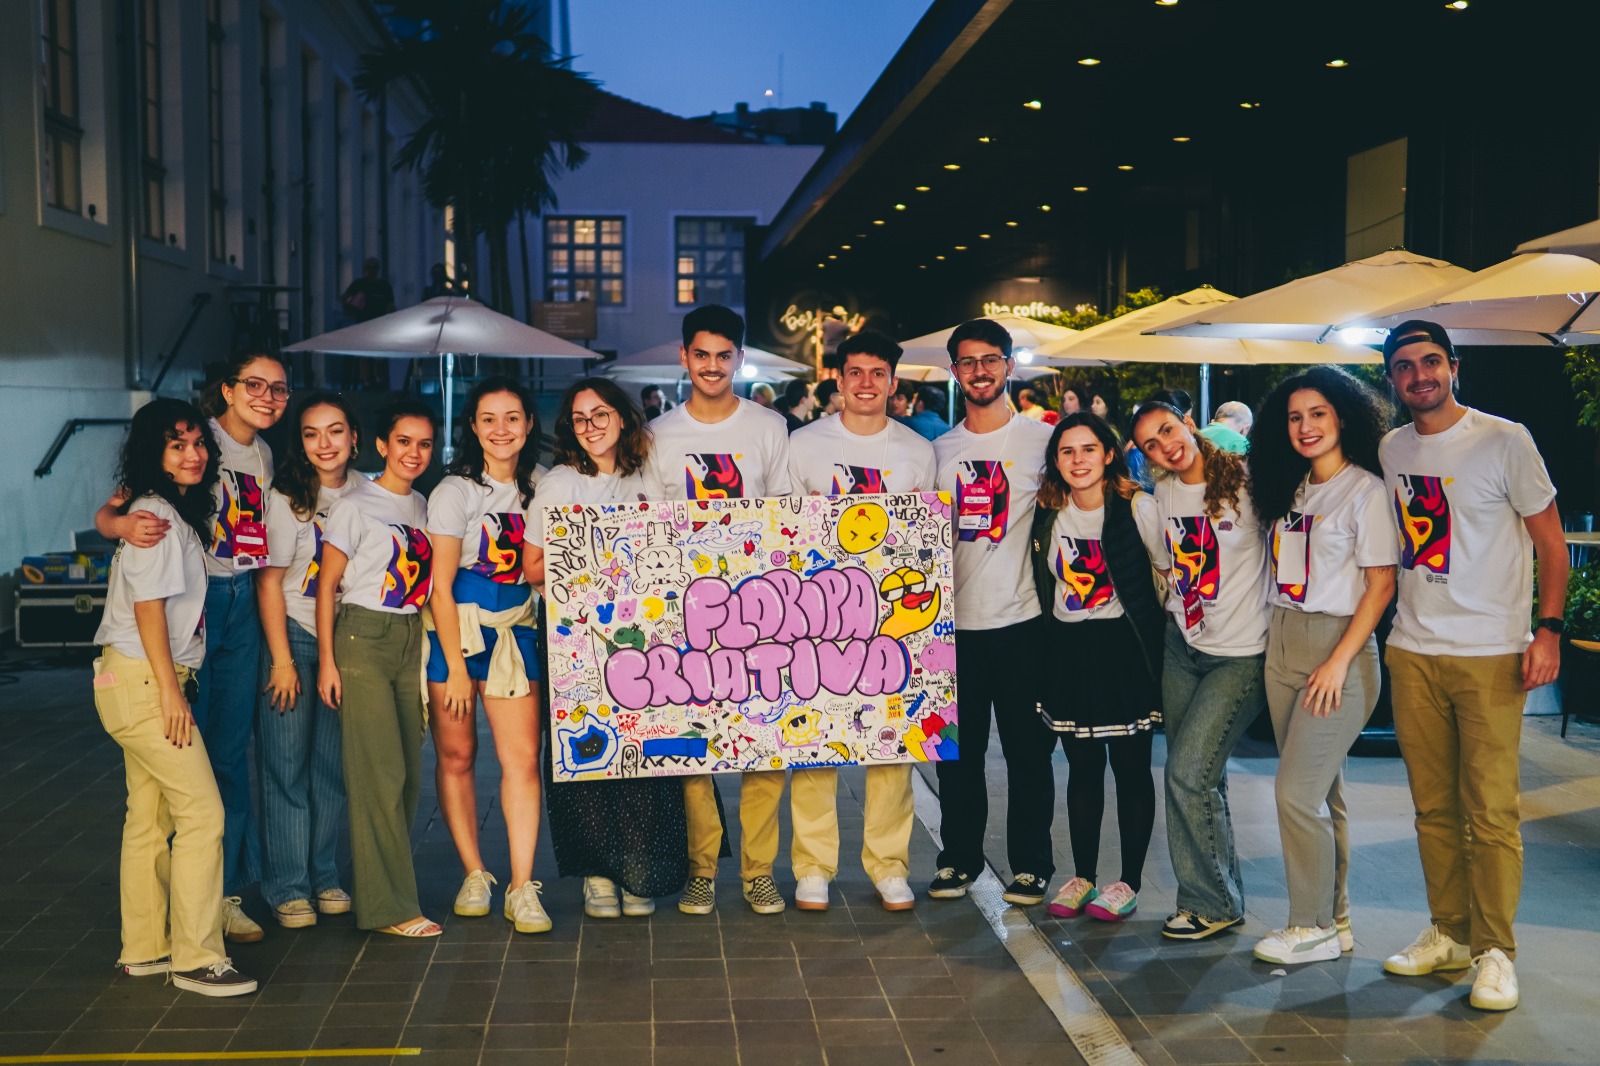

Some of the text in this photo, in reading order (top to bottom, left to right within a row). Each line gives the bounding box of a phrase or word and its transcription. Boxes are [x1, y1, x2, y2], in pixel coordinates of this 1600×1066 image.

[983, 301, 1011, 316] the
[564, 511, 587, 571] JESUS
[684, 567, 877, 651] FLORIPA
[603, 634, 908, 710] CRIATIVA
